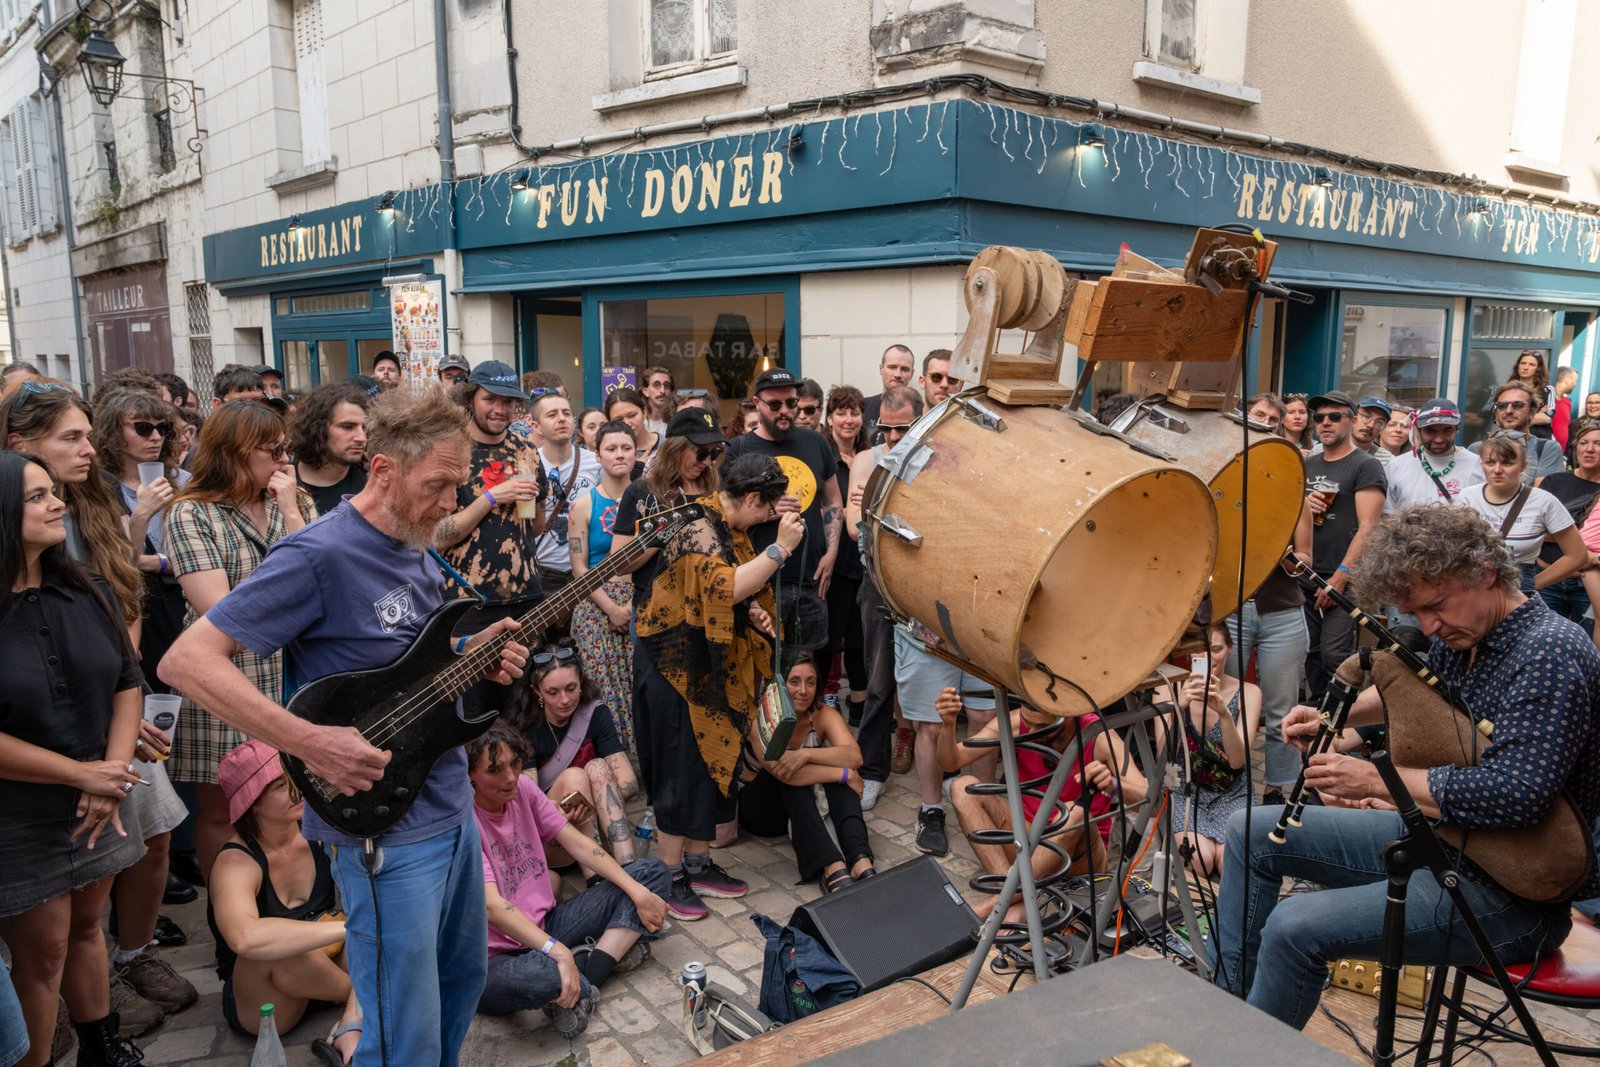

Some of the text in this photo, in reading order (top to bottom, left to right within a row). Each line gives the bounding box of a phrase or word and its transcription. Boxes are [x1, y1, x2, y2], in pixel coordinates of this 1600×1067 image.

[537, 151, 783, 229] FUN DONER
[1237, 173, 1414, 239] RESTAURANT
[260, 215, 363, 268] RESTAURANT
[1502, 218, 1540, 256] FUN
[97, 284, 145, 313] TAILLEUR
